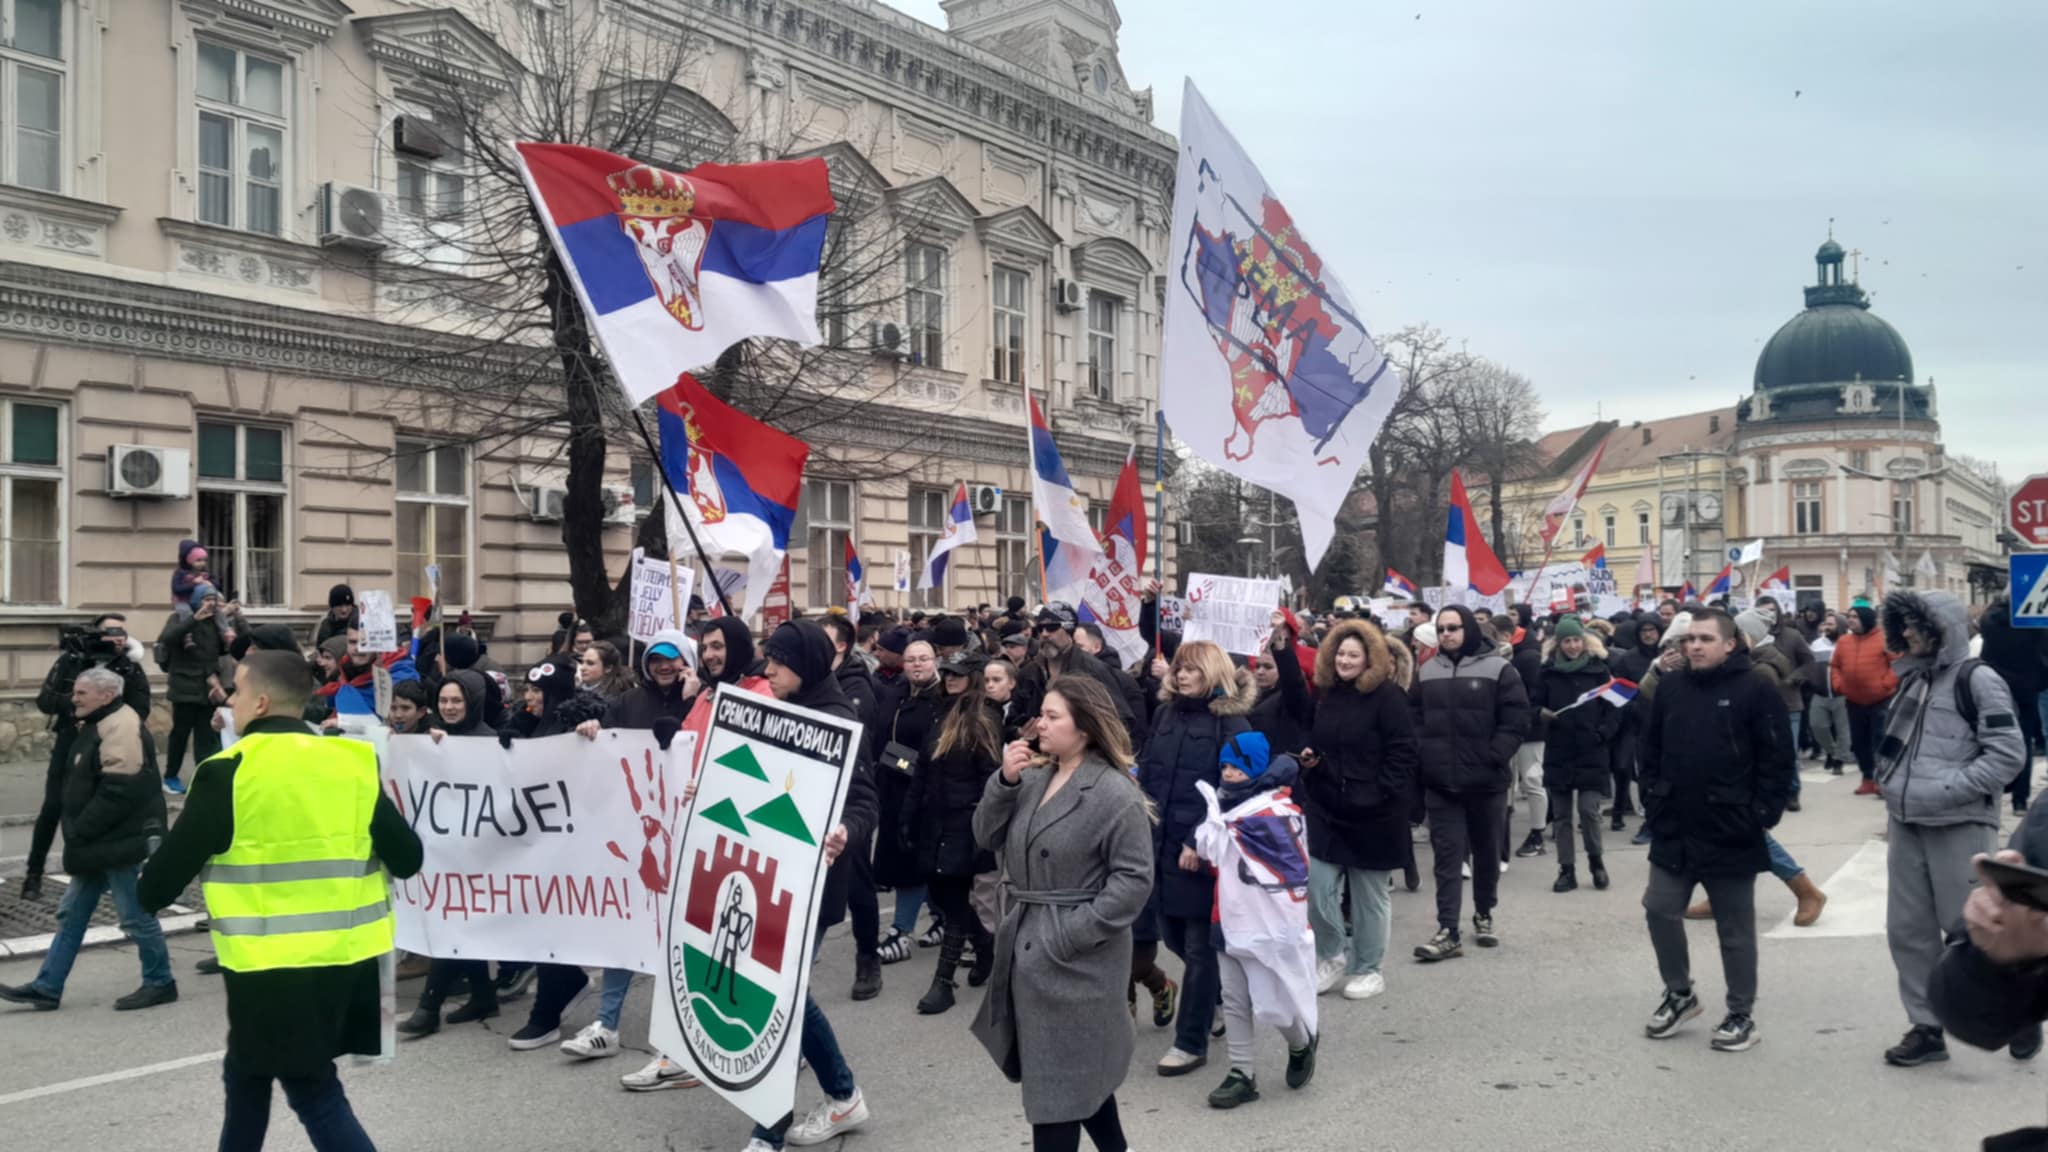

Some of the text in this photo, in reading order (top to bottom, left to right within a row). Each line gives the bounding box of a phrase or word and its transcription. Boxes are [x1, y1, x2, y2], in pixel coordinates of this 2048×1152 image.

[2017, 499, 2048, 524] ST
[718, 698, 845, 762] СРЕМСКА МИТРОВИЦА
[408, 779, 576, 838] УСТАЈЕ!
[404, 872, 632, 921] СУДЕНТИМА!
[672, 944, 785, 1076] CIVITAS SANCTI DEMETRII
